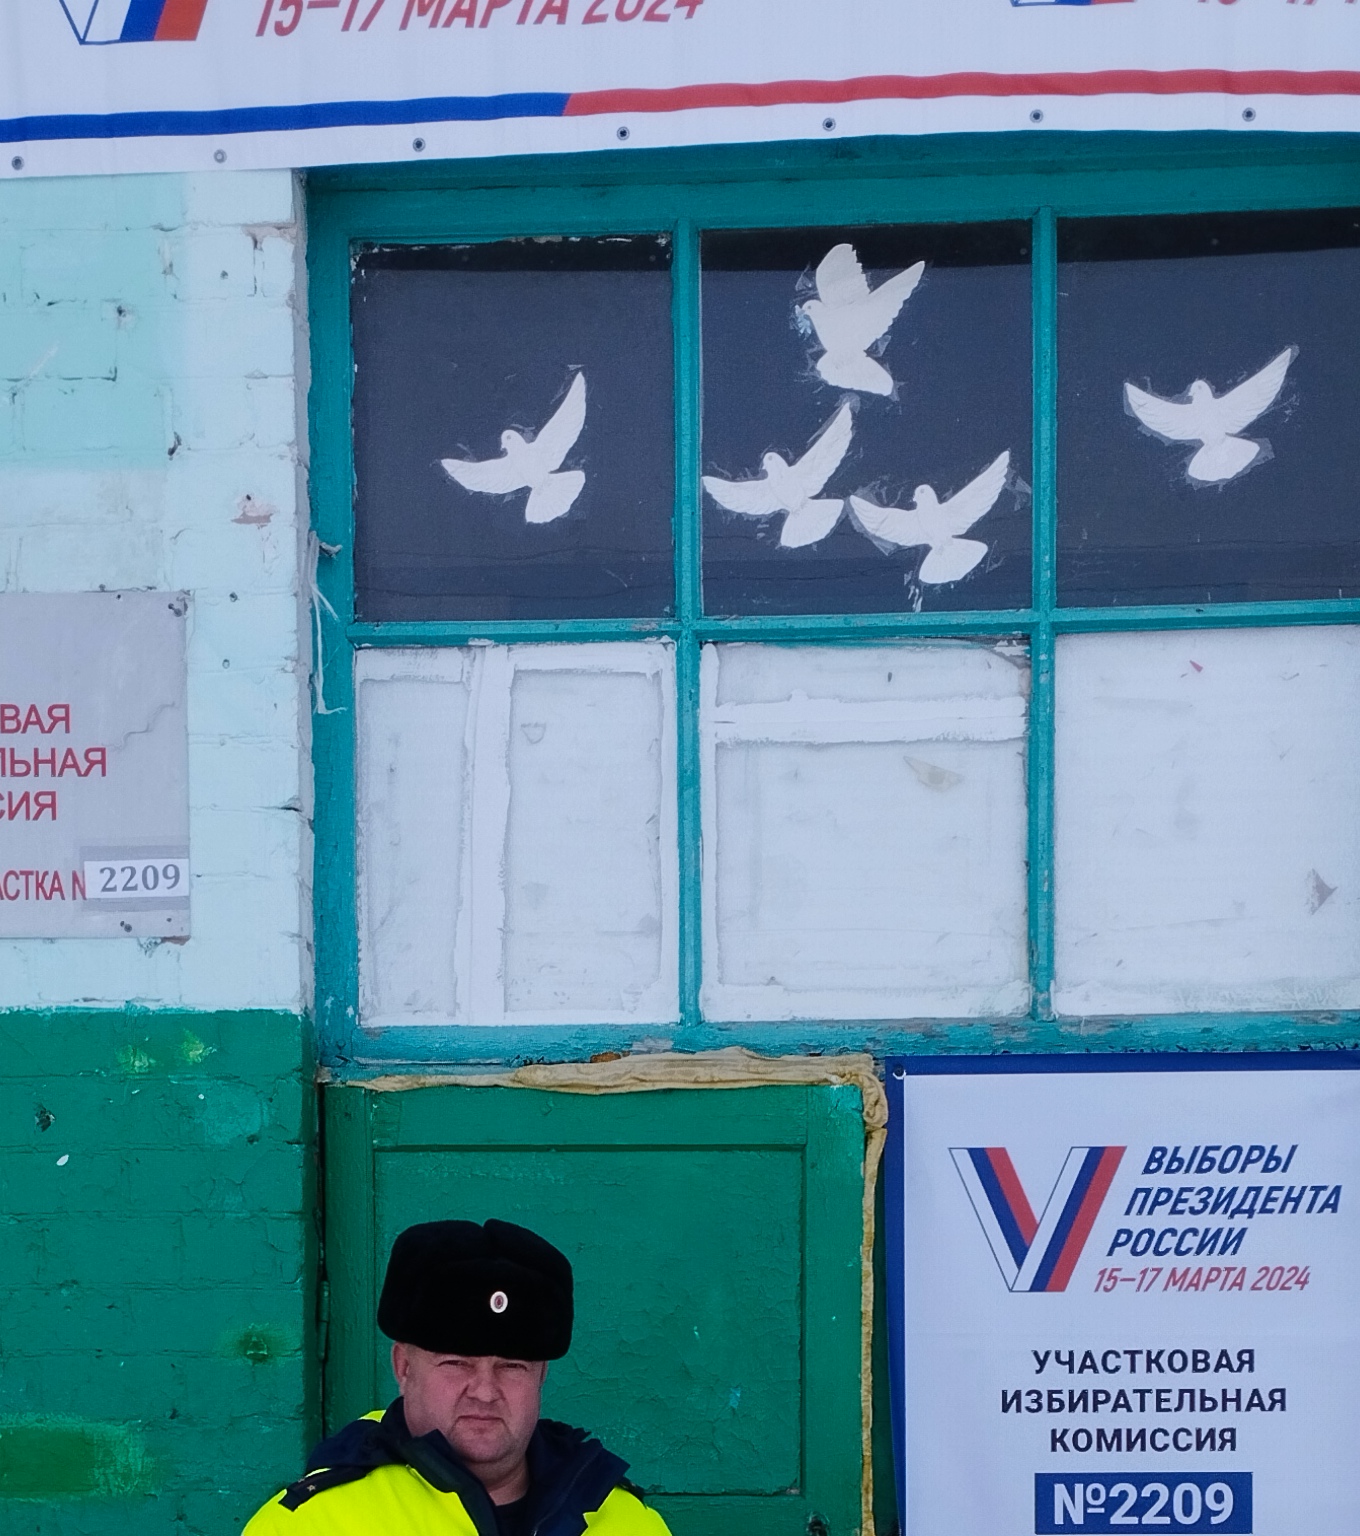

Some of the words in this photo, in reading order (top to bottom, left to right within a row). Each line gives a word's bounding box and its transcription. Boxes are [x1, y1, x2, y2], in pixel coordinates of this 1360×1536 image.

[100, 864, 181, 893] 2209
[1141, 1144, 1298, 1175] ВЫБОРЫ
[1124, 1185, 1342, 1219] ПРЕЗИДЕНТА
[1106, 1228, 1247, 1257] РОССИИ
[1094, 1267, 1162, 1293] 15–17
[1162, 1267, 1247, 1292] МАРТА
[1250, 1266, 1310, 1291] 2024
[1031, 1349, 1255, 1374] УЧАСТКОВАЯ
[1000, 1388, 1286, 1414] ИЗБИРАТЕЛЬНАЯ
[1050, 1428, 1237, 1452] КОМИССИЯ
[1053, 1482, 1234, 1525] №2209
